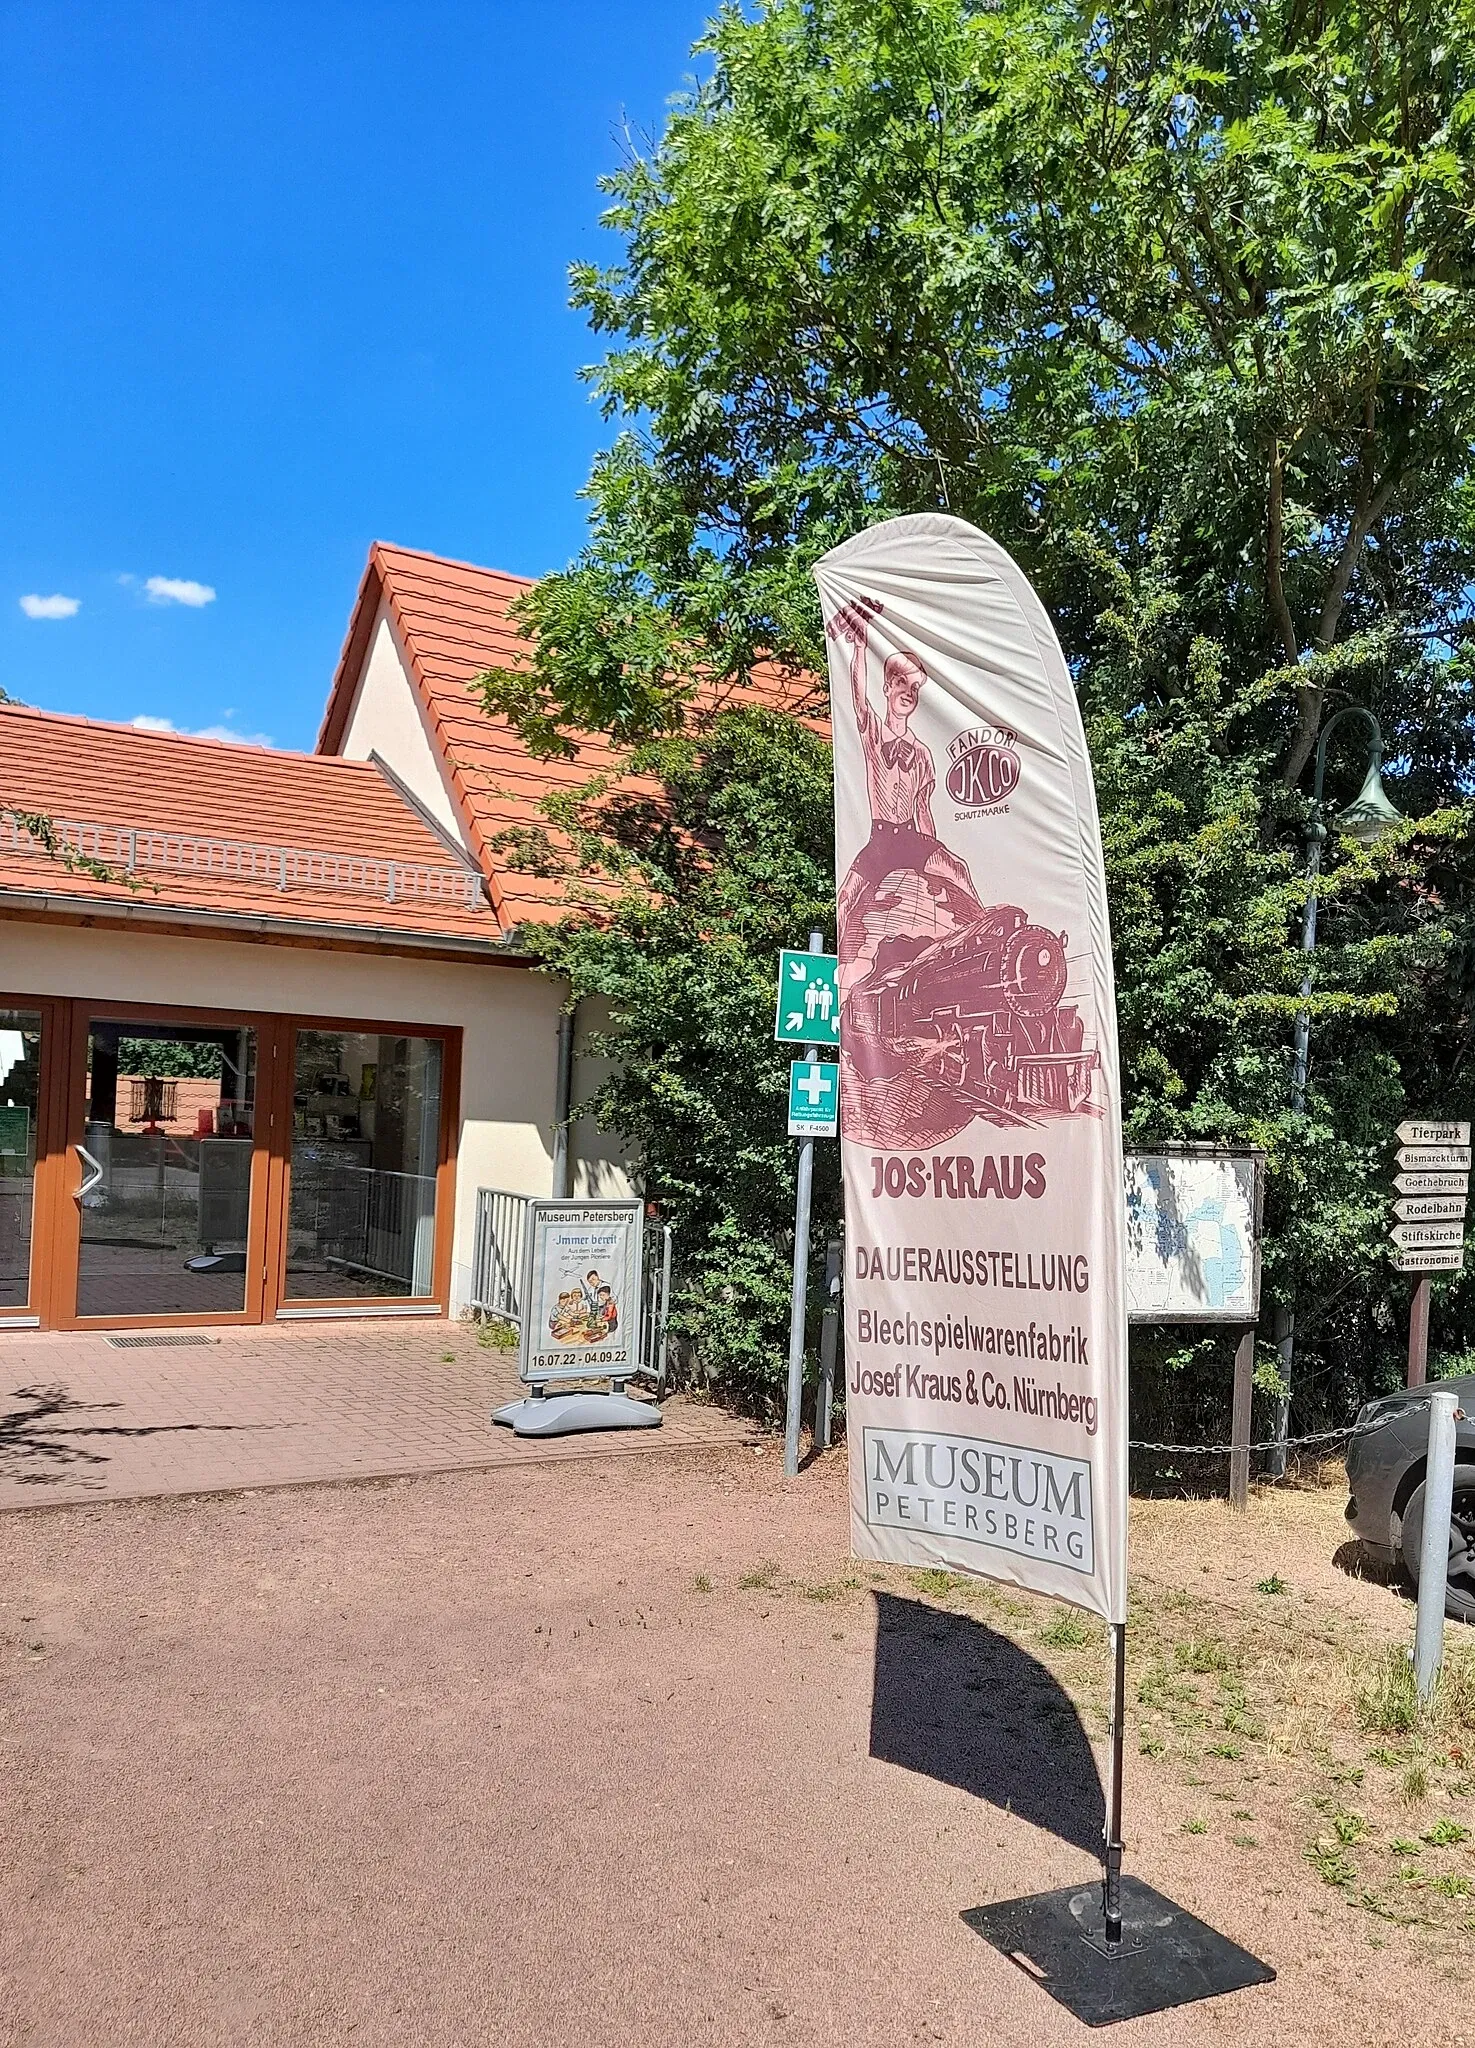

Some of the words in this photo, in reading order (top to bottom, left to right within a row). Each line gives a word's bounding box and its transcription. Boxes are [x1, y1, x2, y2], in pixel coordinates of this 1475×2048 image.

[949, 729, 1013, 759] FANDOR
[954, 804, 1010, 822] SCHUTZMARKE
[796, 1123, 805, 1131] SK
[809, 1124, 830, 1132] F-4500
[1411, 1126, 1462, 1141] Tierpark
[1404, 1153, 1468, 1163] Bismarckturm
[1405, 1177, 1464, 1187] Goethebruch
[1406, 1202, 1462, 1215] Rodelbahn
[538, 1211, 580, 1222] Museum
[583, 1211, 634, 1224] Petersberg
[1401, 1230, 1461, 1242] Stiftskirche
[1397, 1254, 1460, 1266] Gastronomie
[855, 1246, 1089, 1294] DAUERAUSSTELLUNG
[857, 1308, 1089, 1366] Blechspielwarenfabrik
[532, 1354, 576, 1367] 16.07.22
[585, 1350, 627, 1364] 04.09.22
[850, 1360, 903, 1398] Josef
[905, 1363, 962, 1403] Kraus
[965, 1368, 980, 1407] &
[981, 1371, 1011, 1411] Co.
[1013, 1375, 1099, 1436] Nürnberg
[872, 1439, 1086, 1521] MUSEUM
[876, 1492, 1084, 1560] PETERSBERG
